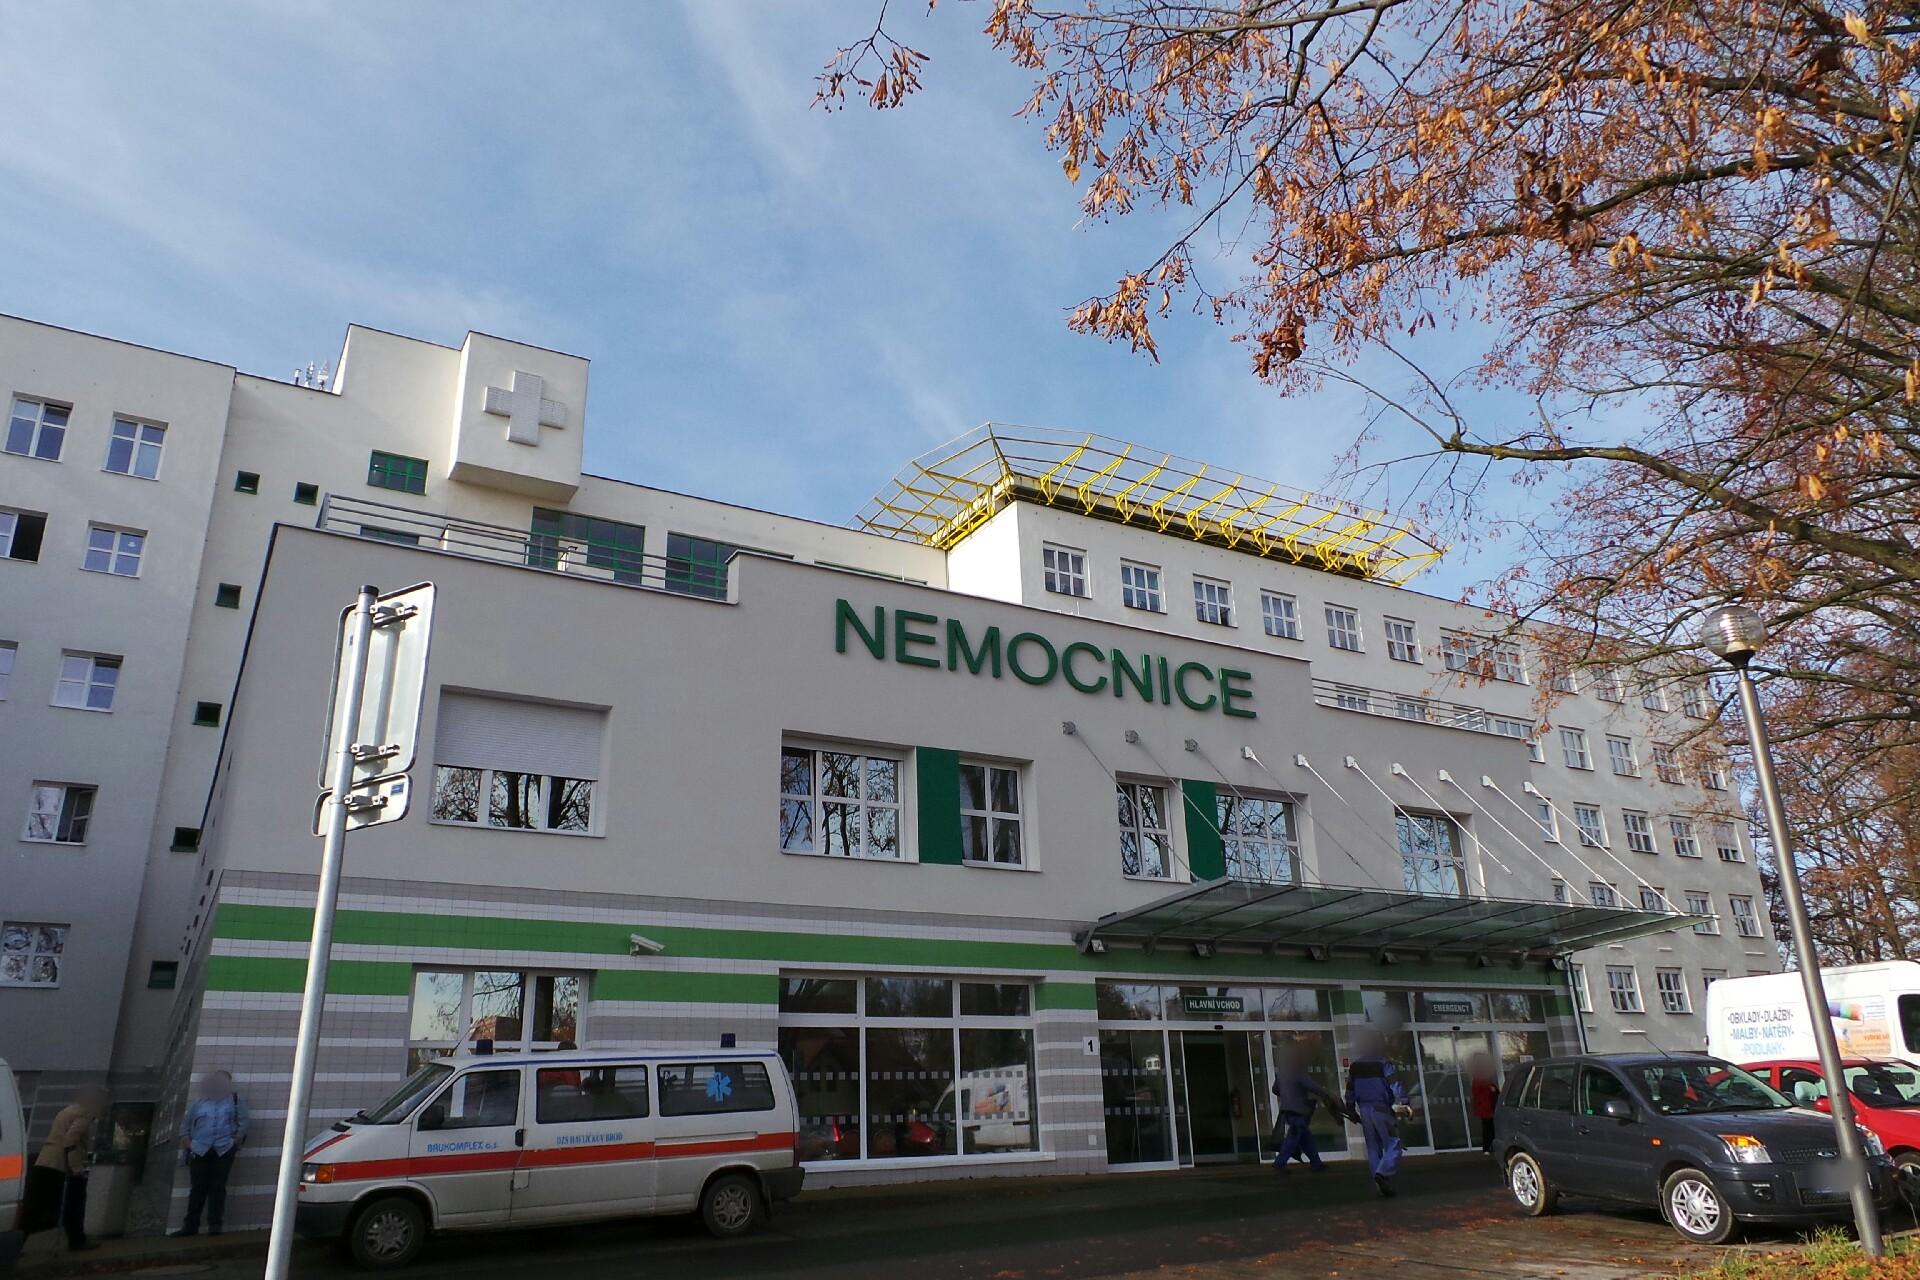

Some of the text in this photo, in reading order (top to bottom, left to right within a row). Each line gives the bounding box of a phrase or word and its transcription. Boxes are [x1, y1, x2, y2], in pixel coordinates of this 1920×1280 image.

[836, 598, 1257, 719] NEMOCNICE
[1215, 1000, 1240, 1009] VCHOD
[1088, 1039, 1094, 1053] 1
[605, 1131, 624, 1145] BROD
